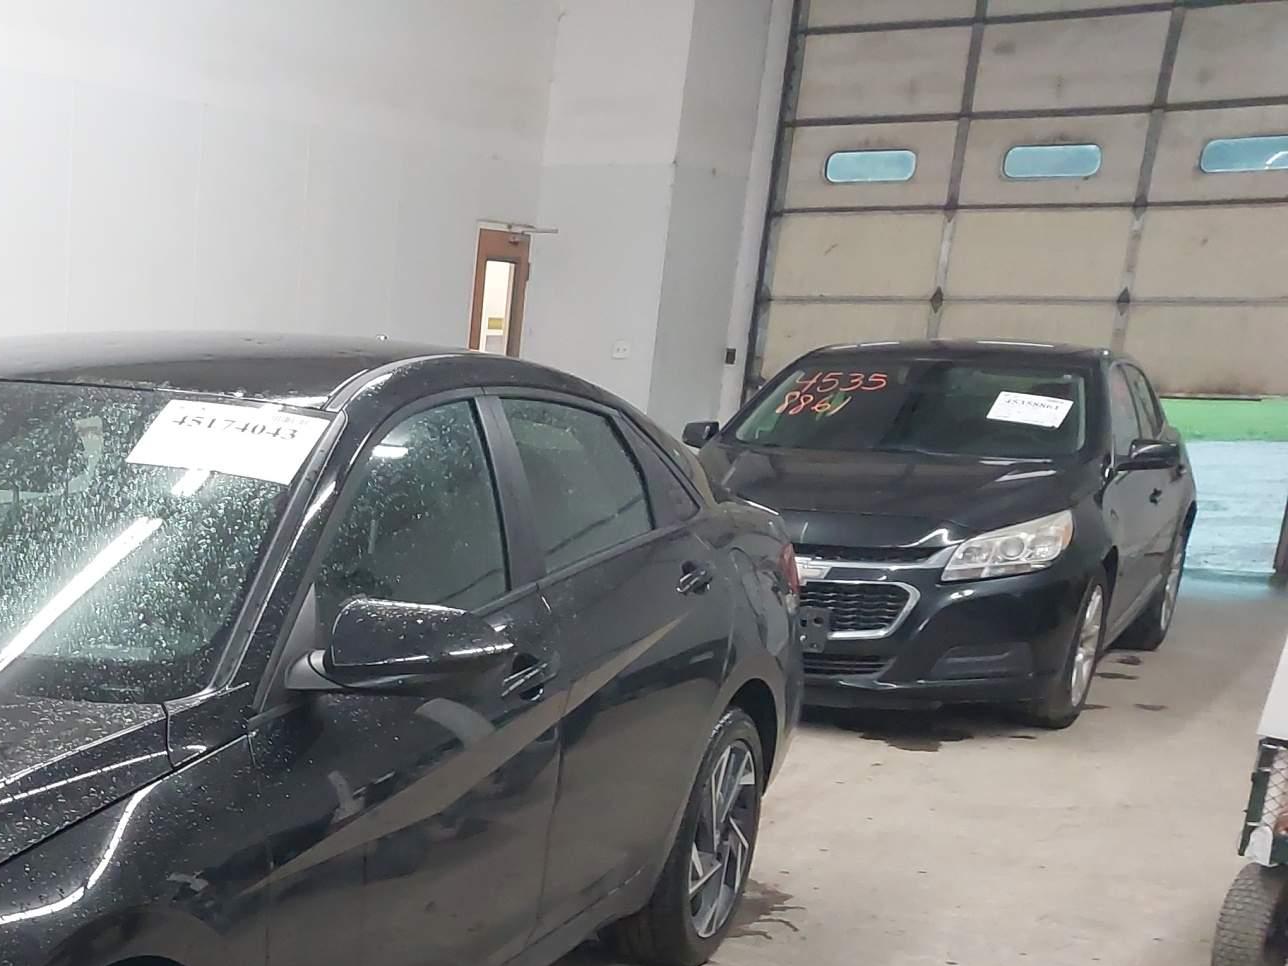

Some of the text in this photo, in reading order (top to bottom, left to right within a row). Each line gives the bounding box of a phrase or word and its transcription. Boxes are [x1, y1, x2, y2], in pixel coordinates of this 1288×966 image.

[796, 372, 888, 392] 4535
[775, 391, 852, 416] 8861
[172, 415, 298, 440] 45174043
